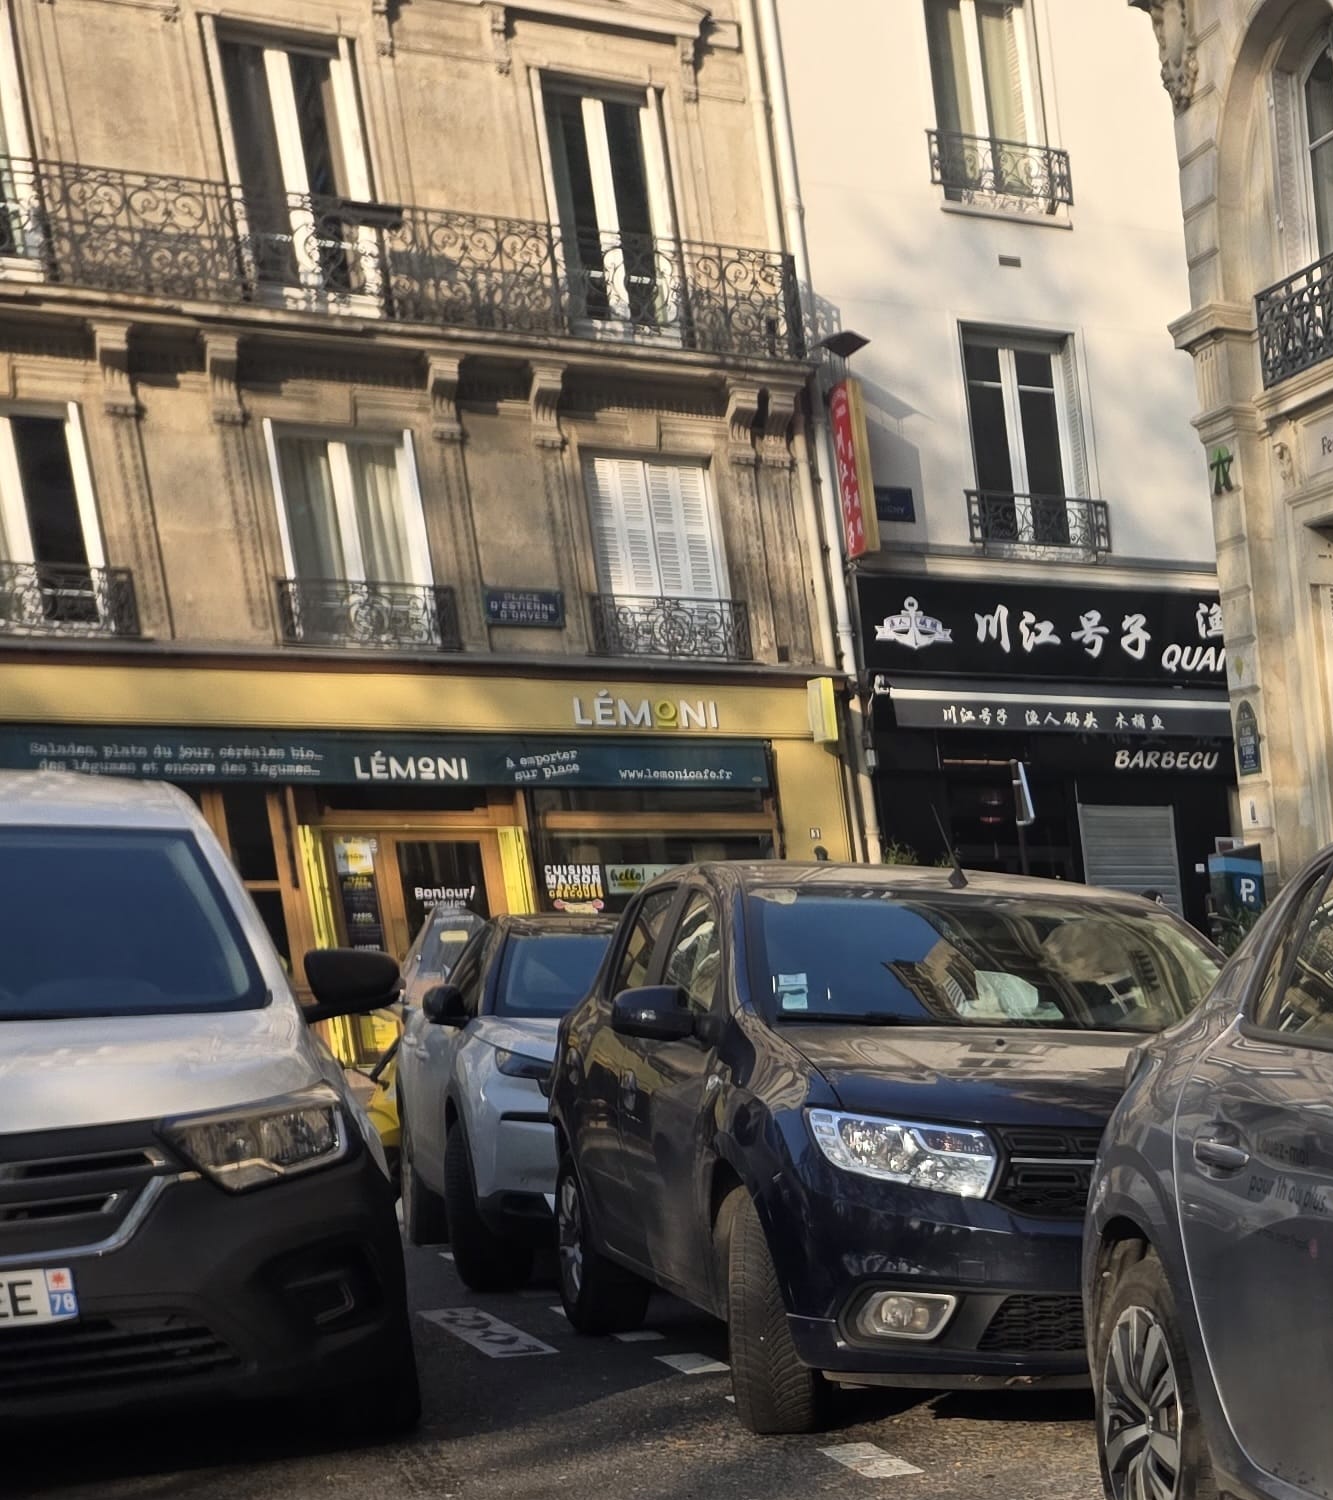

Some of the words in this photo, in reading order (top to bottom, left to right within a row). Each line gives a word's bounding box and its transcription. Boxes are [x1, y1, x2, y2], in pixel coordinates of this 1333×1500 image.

[974, 603, 1151, 661] 川江号子
[572, 689, 720, 730] LÉMONI
[942, 705, 1009, 727] 川江号子
[353, 750, 469, 781] LÉMONI
[519, 750, 578, 767] emporter
[514, 767, 538, 781] sur
[543, 762, 580, 779] place
[618, 768, 734, 780] www.lemonicafe.fr
[544, 864, 600, 875] CUISINE
[546, 874, 601, 884] MAISON
[50, 1292, 76, 1313] 78
